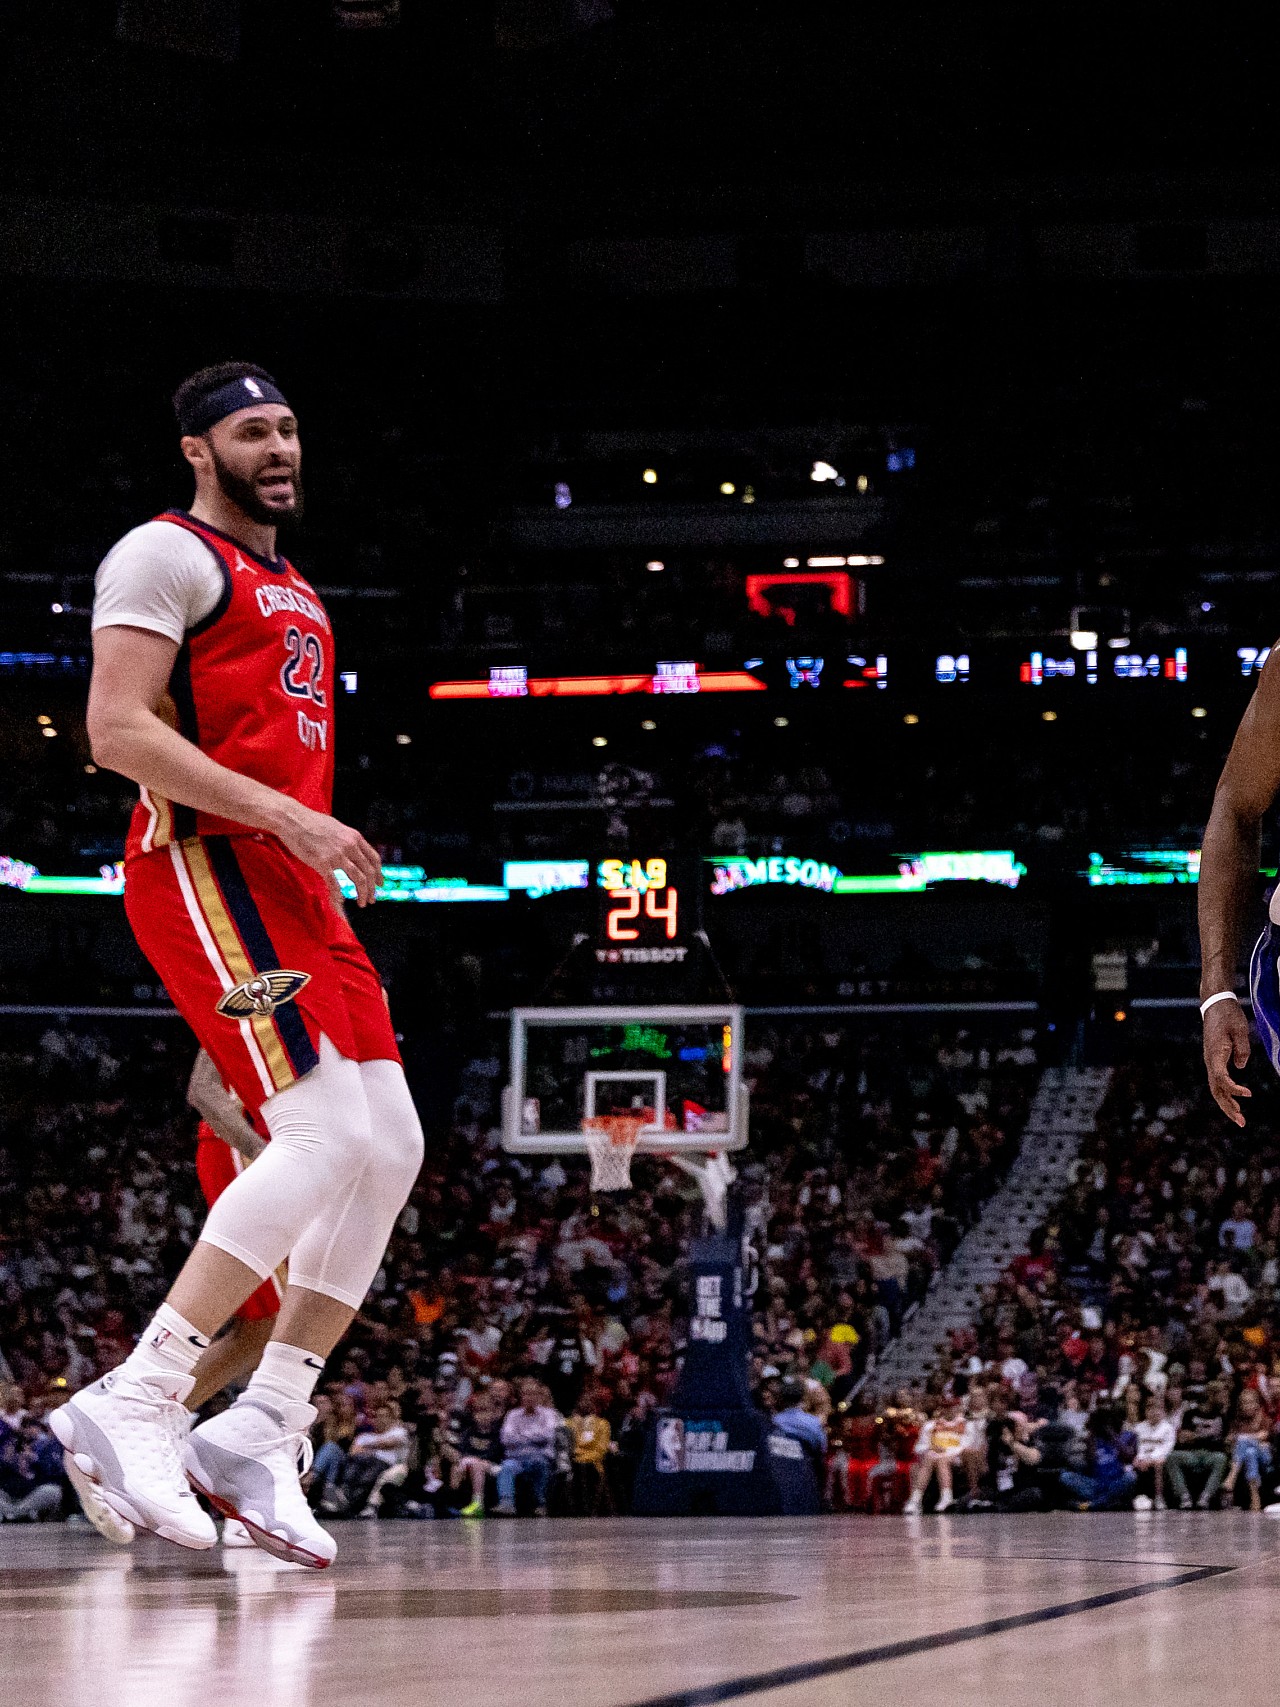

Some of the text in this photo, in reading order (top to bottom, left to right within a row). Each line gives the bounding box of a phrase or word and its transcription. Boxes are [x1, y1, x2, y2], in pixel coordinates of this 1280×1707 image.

[255, 584, 331, 634] CRESCEN
[280, 625, 327, 708] 22
[297, 711, 328, 750] CITY
[608, 887, 678, 940] 24
